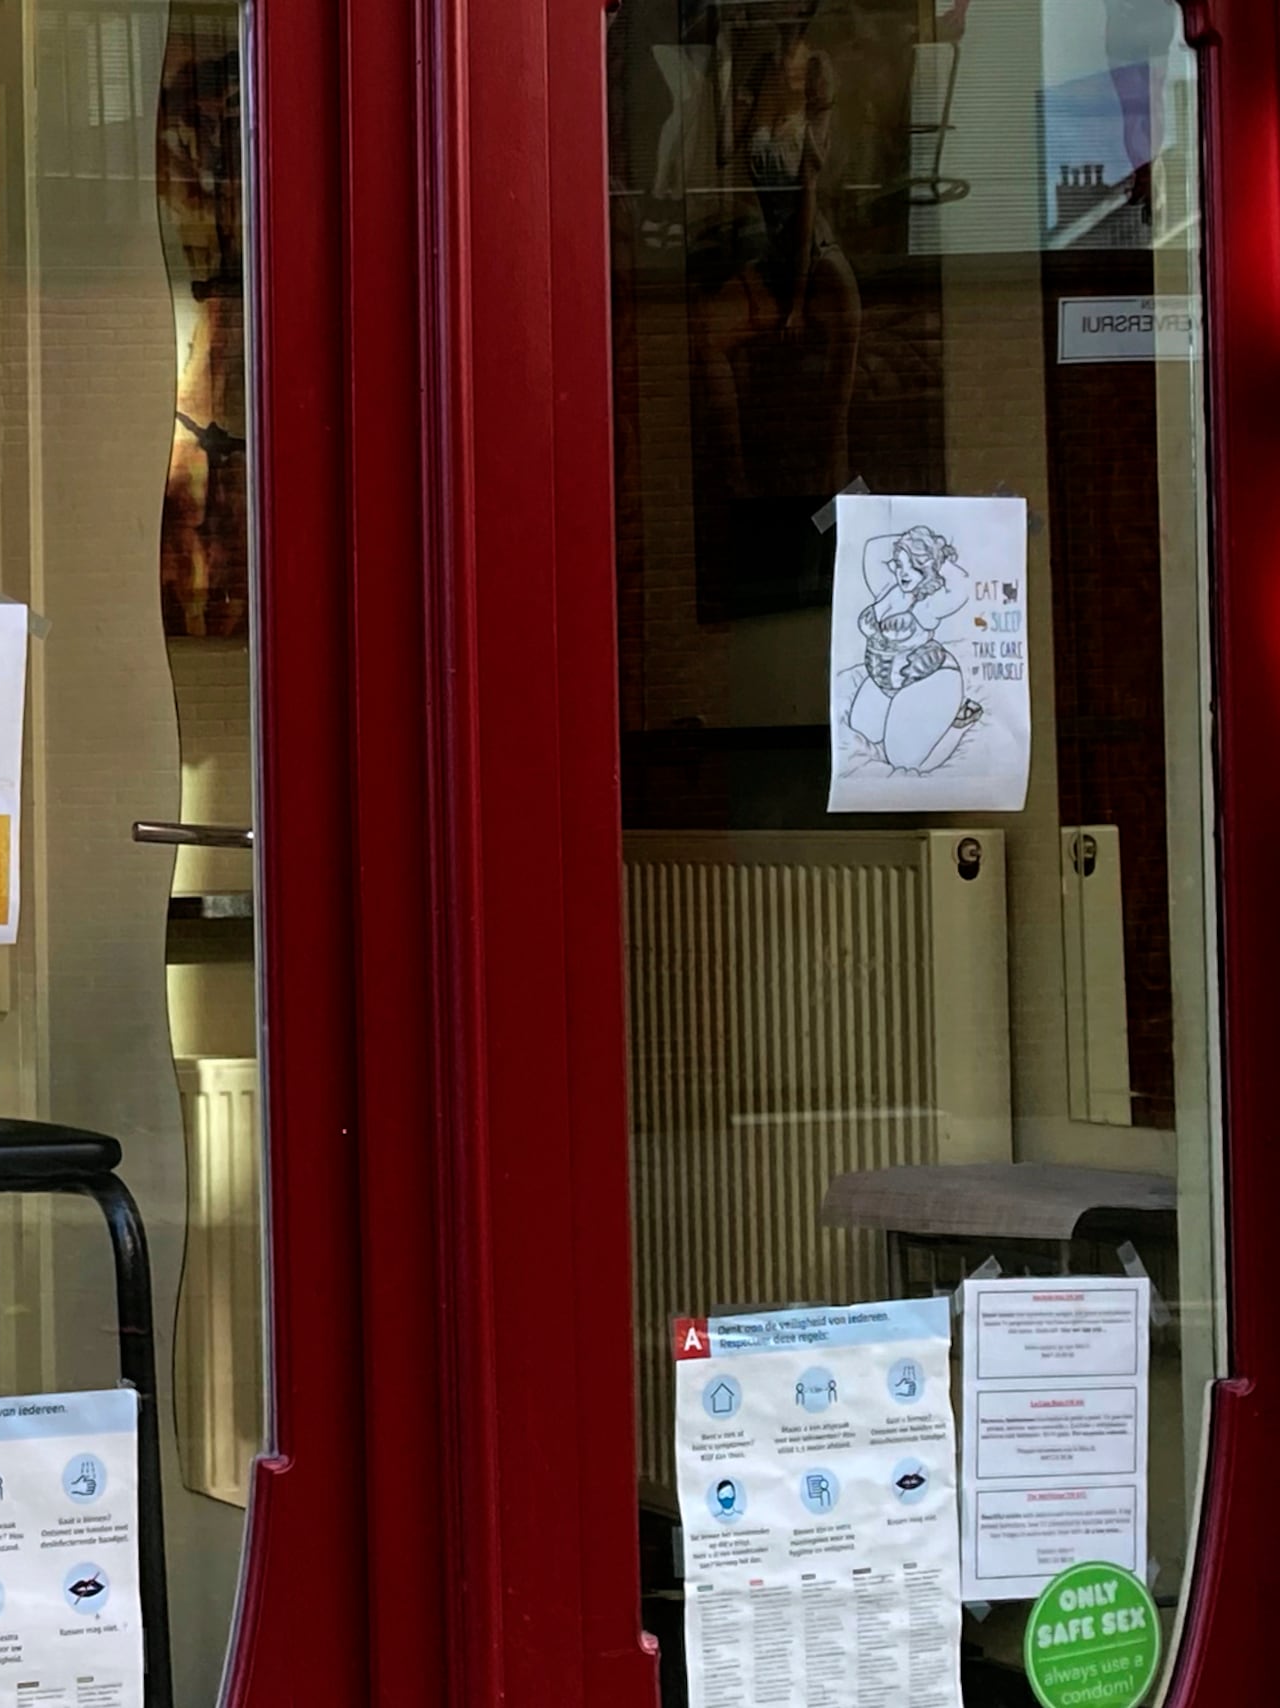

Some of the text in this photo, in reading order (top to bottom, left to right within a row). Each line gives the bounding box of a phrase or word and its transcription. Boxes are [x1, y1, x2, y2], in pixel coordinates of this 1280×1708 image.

[975, 580, 998, 601] EAT
[990, 611, 1022, 632] SLEEP
[972, 641, 1023, 659] TAKE CARE
[982, 662, 1024, 680] YOURSELF
[1059, 1580, 1118, 1612] ONLY
[1037, 1604, 1146, 1649] SAFE SEX
[1044, 1655, 1144, 1687] always use a
[1061, 1673, 1134, 1706] condom!
